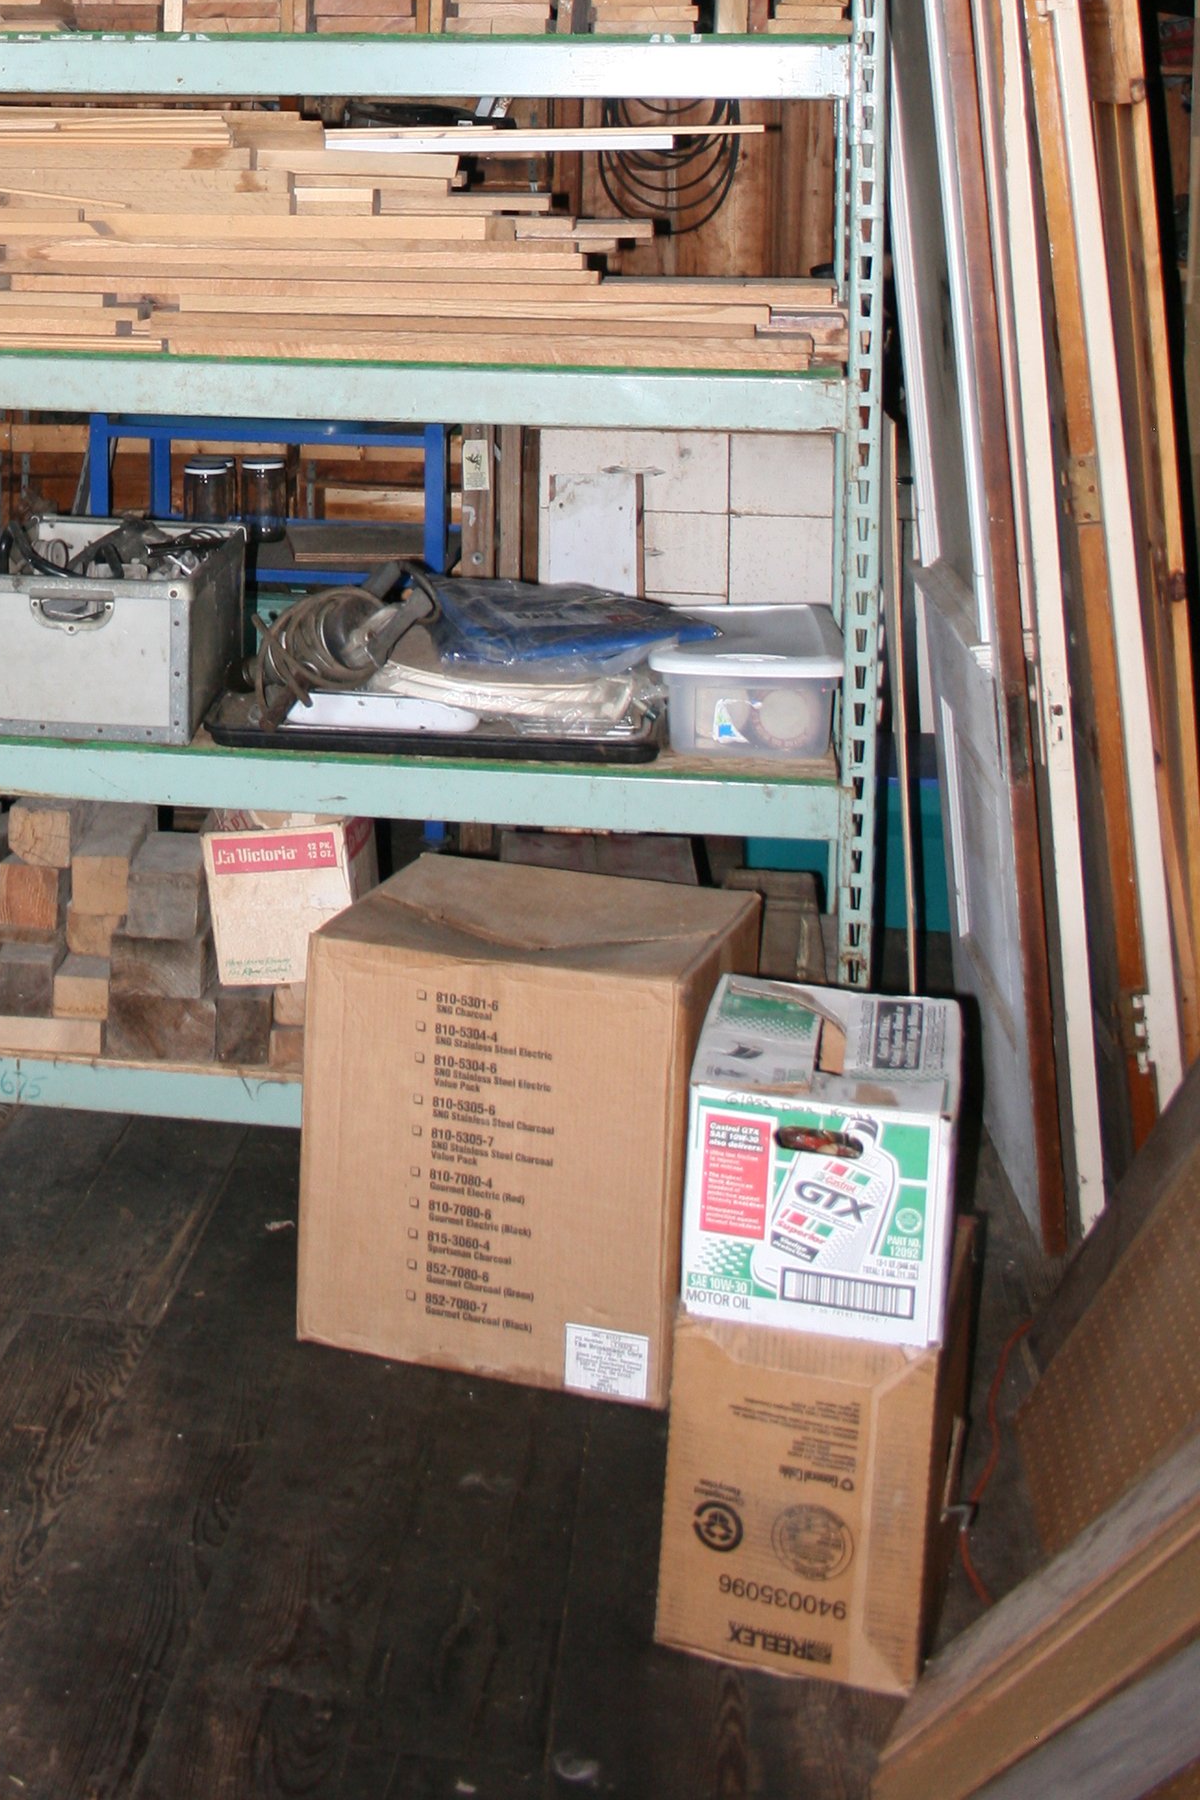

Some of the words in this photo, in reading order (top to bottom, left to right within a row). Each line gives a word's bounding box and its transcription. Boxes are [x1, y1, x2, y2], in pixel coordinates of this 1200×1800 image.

[215, 849, 235, 865] La
[236, 845, 298, 863] Victoria
[320, 850, 334, 858] OZ.
[436, 992, 499, 1012] 810-5301-6
[455, 1007, 492, 1021] Charcoal
[435, 1023, 498, 1042] 810-5304-4
[454, 1038, 493, 1053] Stainless
[494, 1045, 517, 1056] Steel
[519, 1047, 552, 1061] Electric
[434, 1054, 497, 1074] 810-5304-6
[434, 1078, 458, 1090] Value
[459, 1081, 480, 1093] Pack
[453, 1069, 491, 1084] Stainless
[493, 1076, 516, 1088] Steel
[518, 1079, 552, 1092] Electric
[432, 1096, 496, 1115] 810-5305-6
[451, 1111, 490, 1126] Stainless
[492, 1117, 515, 1129] Steel
[517, 1120, 555, 1135] Charcoal
[710, 1122, 740, 1133] Castrol
[741, 1126, 760, 1136] GTX
[431, 1128, 494, 1147] 810-5305-7
[709, 1130, 726, 1139] SAE
[729, 1132, 759, 1143] 10W-30
[709, 1139, 727, 1148] also
[728, 1141, 764, 1153] delivers:
[431, 1150, 455, 1163] Value
[457, 1154, 478, 1166] Pack
[450, 1142, 489, 1157] Stainless
[491, 1148, 513, 1161] Steel
[515, 1152, 553, 1167] Charcoal
[429, 1168, 493, 1189] 810-7080-4
[825, 1174, 857, 1194] Castrol
[429, 1181, 466, 1196] Gourmet
[467, 1188, 500, 1201] Electric
[502, 1192, 525, 1205] (Red)
[794, 1180, 876, 1224] GTX
[428, 1200, 492, 1220] 810-7080-6
[429, 1213, 465, 1228] Gourmet
[465, 1220, 499, 1233] Electric
[501, 1223, 532, 1238] (Black)
[775, 1220, 827, 1246] Superior
[427, 1231, 490, 1251] 815-3060-4
[886, 1234, 906, 1247] PART
[906, 1236, 922, 1248] NO.
[427, 1244, 472, 1259] Sportsman
[474, 1251, 512, 1265] Charcoal
[889, 1246, 920, 1258] 12092
[426, 1261, 489, 1282] 852-7080-6
[426, 1275, 462, 1289] Gourmet
[463, 1281, 502, 1295] Charcoal
[690, 1275, 708, 1288] SAE
[709, 1276, 748, 1293] 10W-30
[425, 1292, 488, 1313] 852-7080-7
[685, 1289, 730, 1307] MOTOR
[733, 1293, 751, 1310] OIL
[425, 1306, 461, 1320] Gourmet
[462, 1311, 500, 1327] Charcoal
[502, 1318, 533, 1333] (Black)
[803, 1470, 838, 1488] General
[719, 1573, 847, 1621] 940035096
[729, 1624, 809, 1659] REELEX
